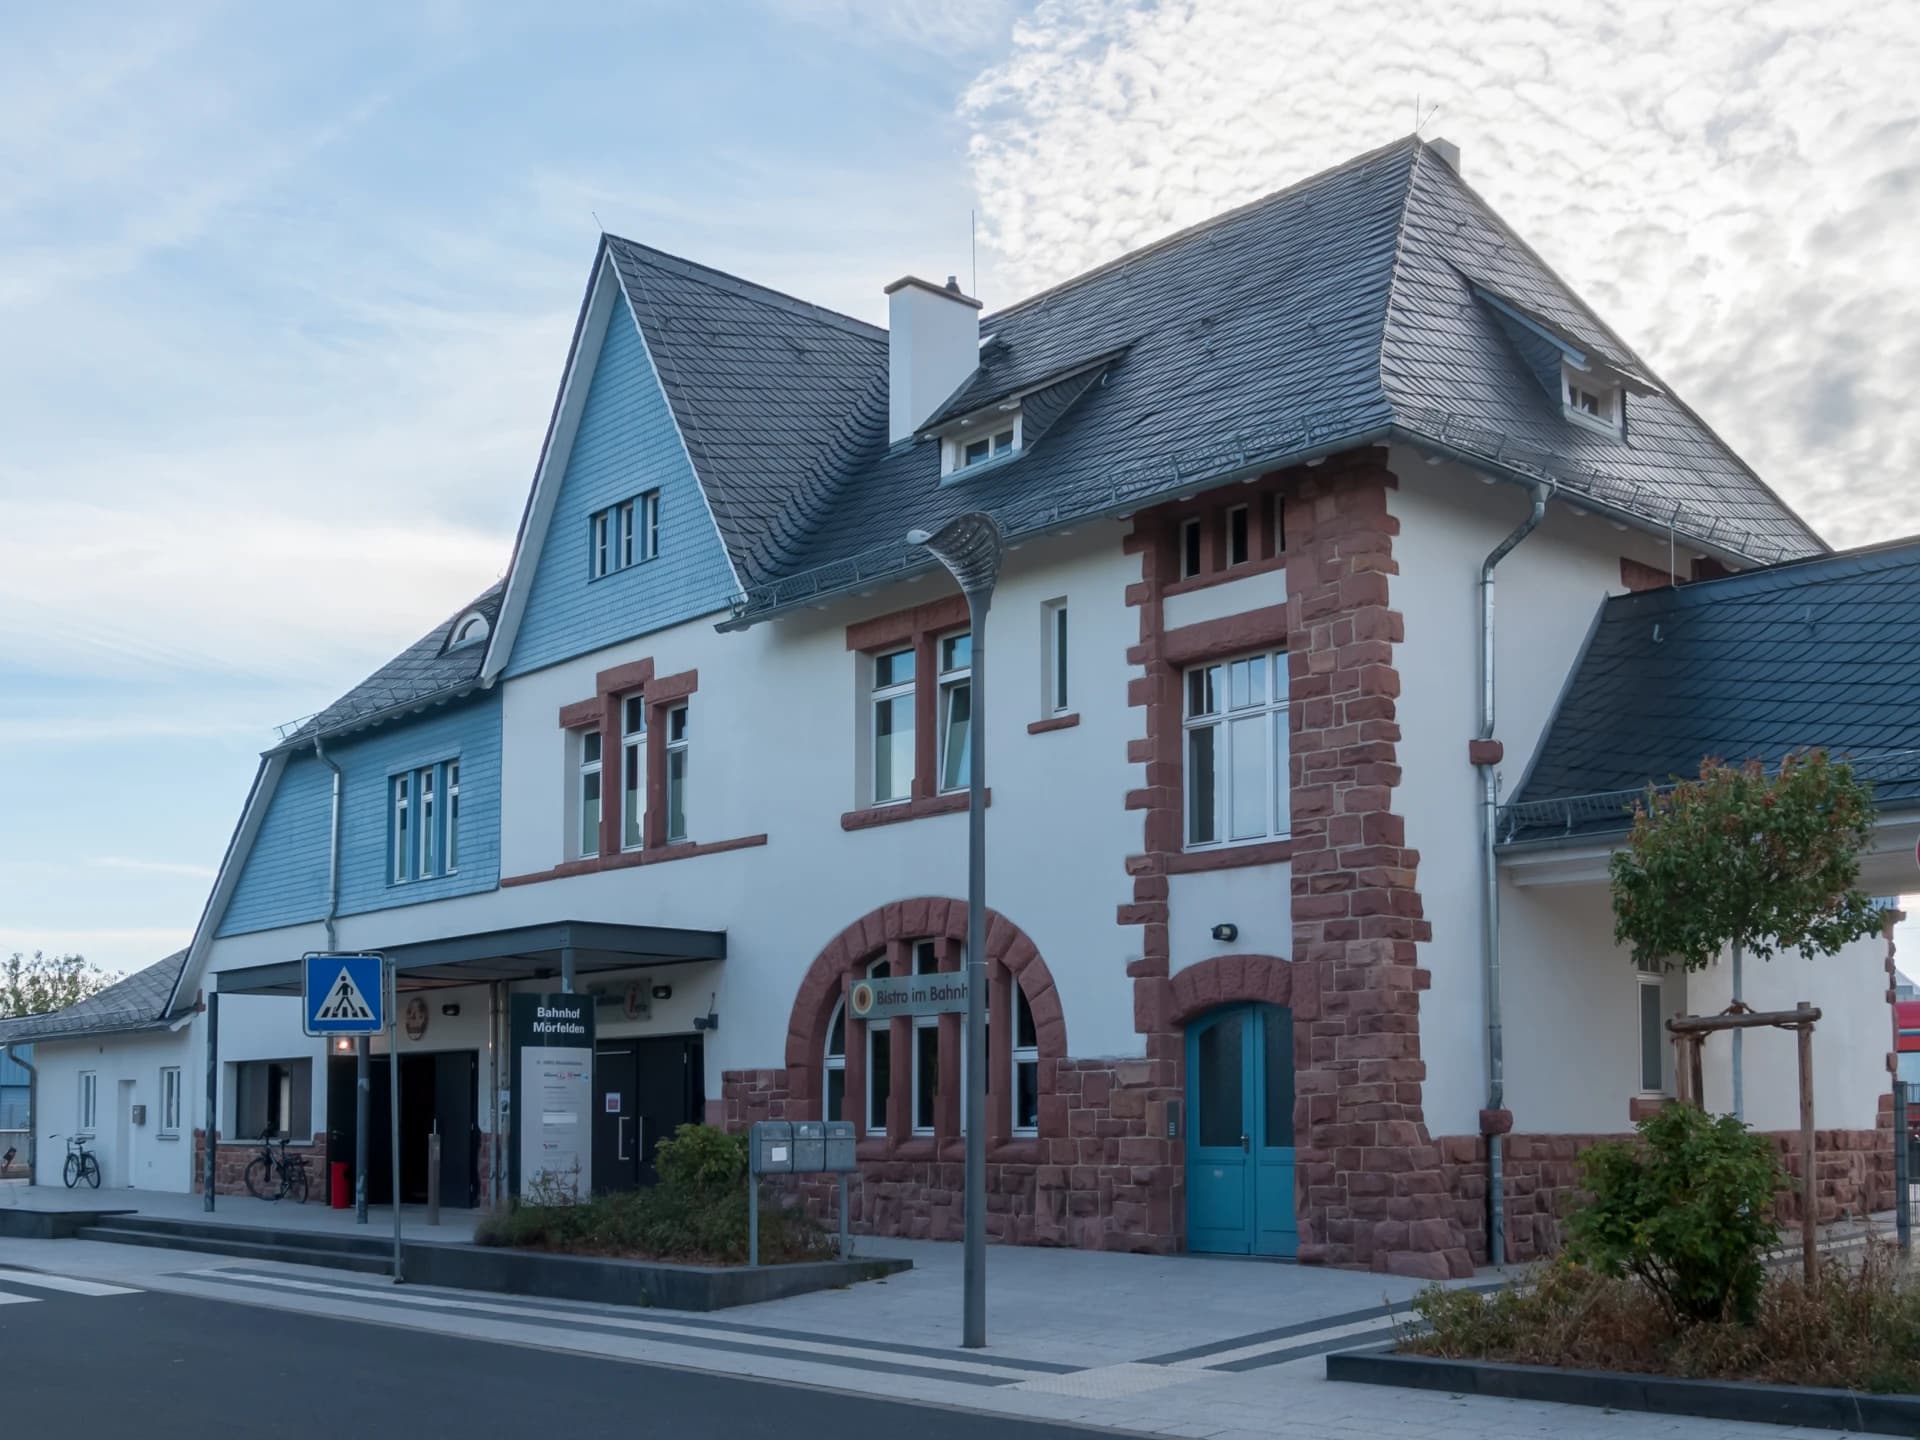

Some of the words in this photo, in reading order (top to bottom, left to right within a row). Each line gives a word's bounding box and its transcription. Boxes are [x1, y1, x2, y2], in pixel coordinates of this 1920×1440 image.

[877, 990, 908, 1005] Bistro
[911, 988, 926, 1002] im
[930, 983, 969, 1001] Bahnh
[537, 1007, 580, 1019] Bahnhof
[533, 1022, 585, 1034] Mörfelden
